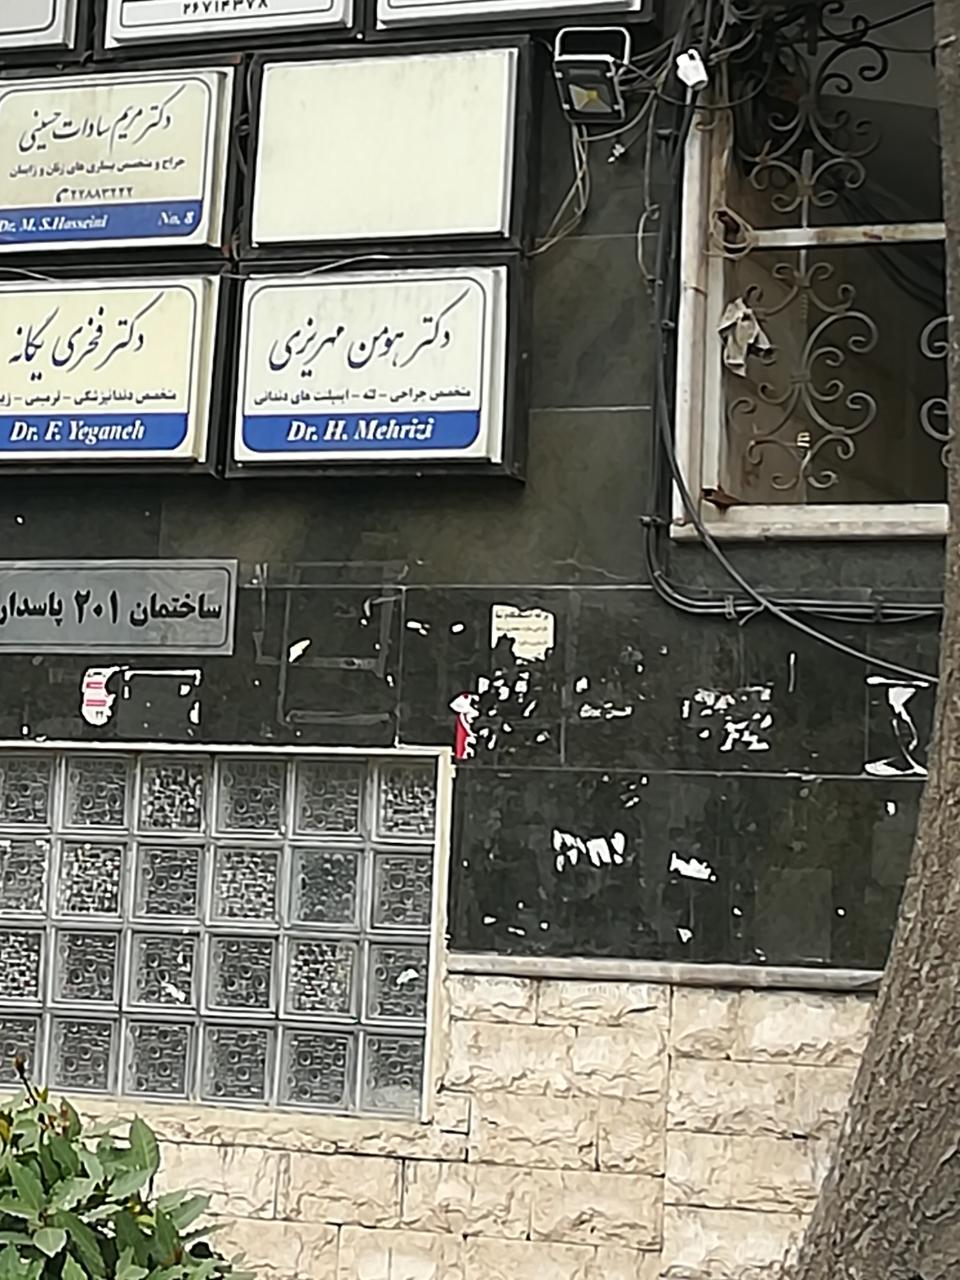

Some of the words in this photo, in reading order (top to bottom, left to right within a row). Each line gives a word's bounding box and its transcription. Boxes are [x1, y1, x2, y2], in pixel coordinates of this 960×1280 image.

[51, 114, 111, 140] سادات
[133, 84, 187, 146] دکتر
[94, 291, 164, 371] دکتر
[399, 286, 472, 368] دکتر
[268, 316, 346, 378] مهریزی
[135, 387, 177, 405] متخصص
[389, 387, 427, 404] جراحی
[429, 385, 472, 401] متخصص
[10, 421, 38, 442] Dr.
[44, 420, 63, 441] F.
[68, 418, 146, 446] Yeganeh
[287, 420, 319, 442] Dr.
[323, 419, 349, 442] H.
[353, 416, 436, 441] Mehrizi
[74, 589, 119, 624] ۲۰۱
[129, 591, 223, 627] ساختمان
